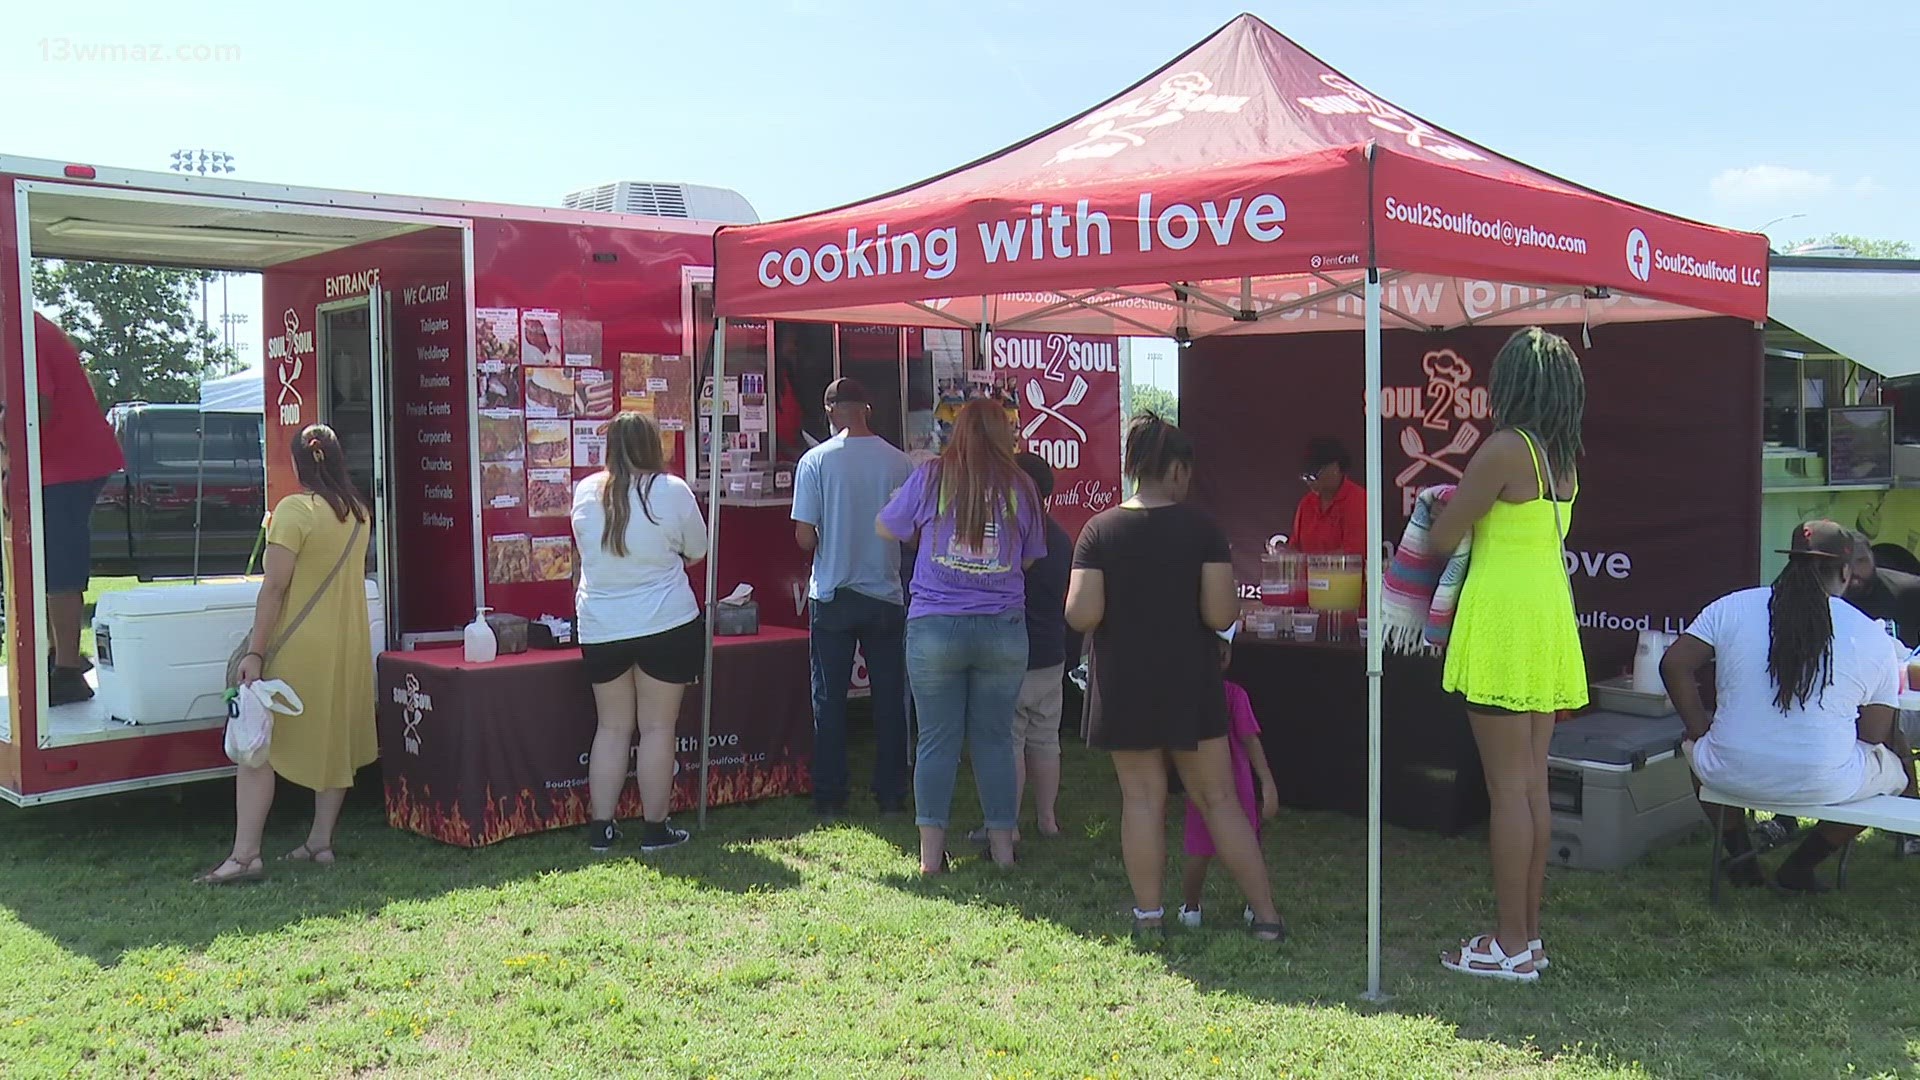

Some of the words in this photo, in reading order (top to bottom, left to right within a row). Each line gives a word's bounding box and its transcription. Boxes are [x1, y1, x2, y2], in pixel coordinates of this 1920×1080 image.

[1385, 196, 1587, 254] Soul2Soulfood@yahoo.com
[758, 223, 957, 288] cooking
[977, 199, 1111, 263] with
[1138, 192, 1286, 252] love
[1654, 248, 1737, 285] Soul2Soulfood
[1741, 265, 1762, 287] LLC
[326, 268, 380, 298] ENTRANCE
[420, 318, 450, 335] Tailgates
[417, 346, 450, 362] Weddings
[420, 374, 450, 388] Reunions
[279, 403, 301, 427] FOOD
[406, 403, 428, 417] Private
[429, 401, 451, 416] Events
[418, 429, 452, 447] Corporate
[421, 458, 453, 473] Churches
[424, 485, 453, 500] Festivals
[1055, 481, 1080, 505] with
[422, 512, 454, 529] Birthdays
[1564, 550, 1631, 579] ove
[749, 752, 765, 763] LLC
